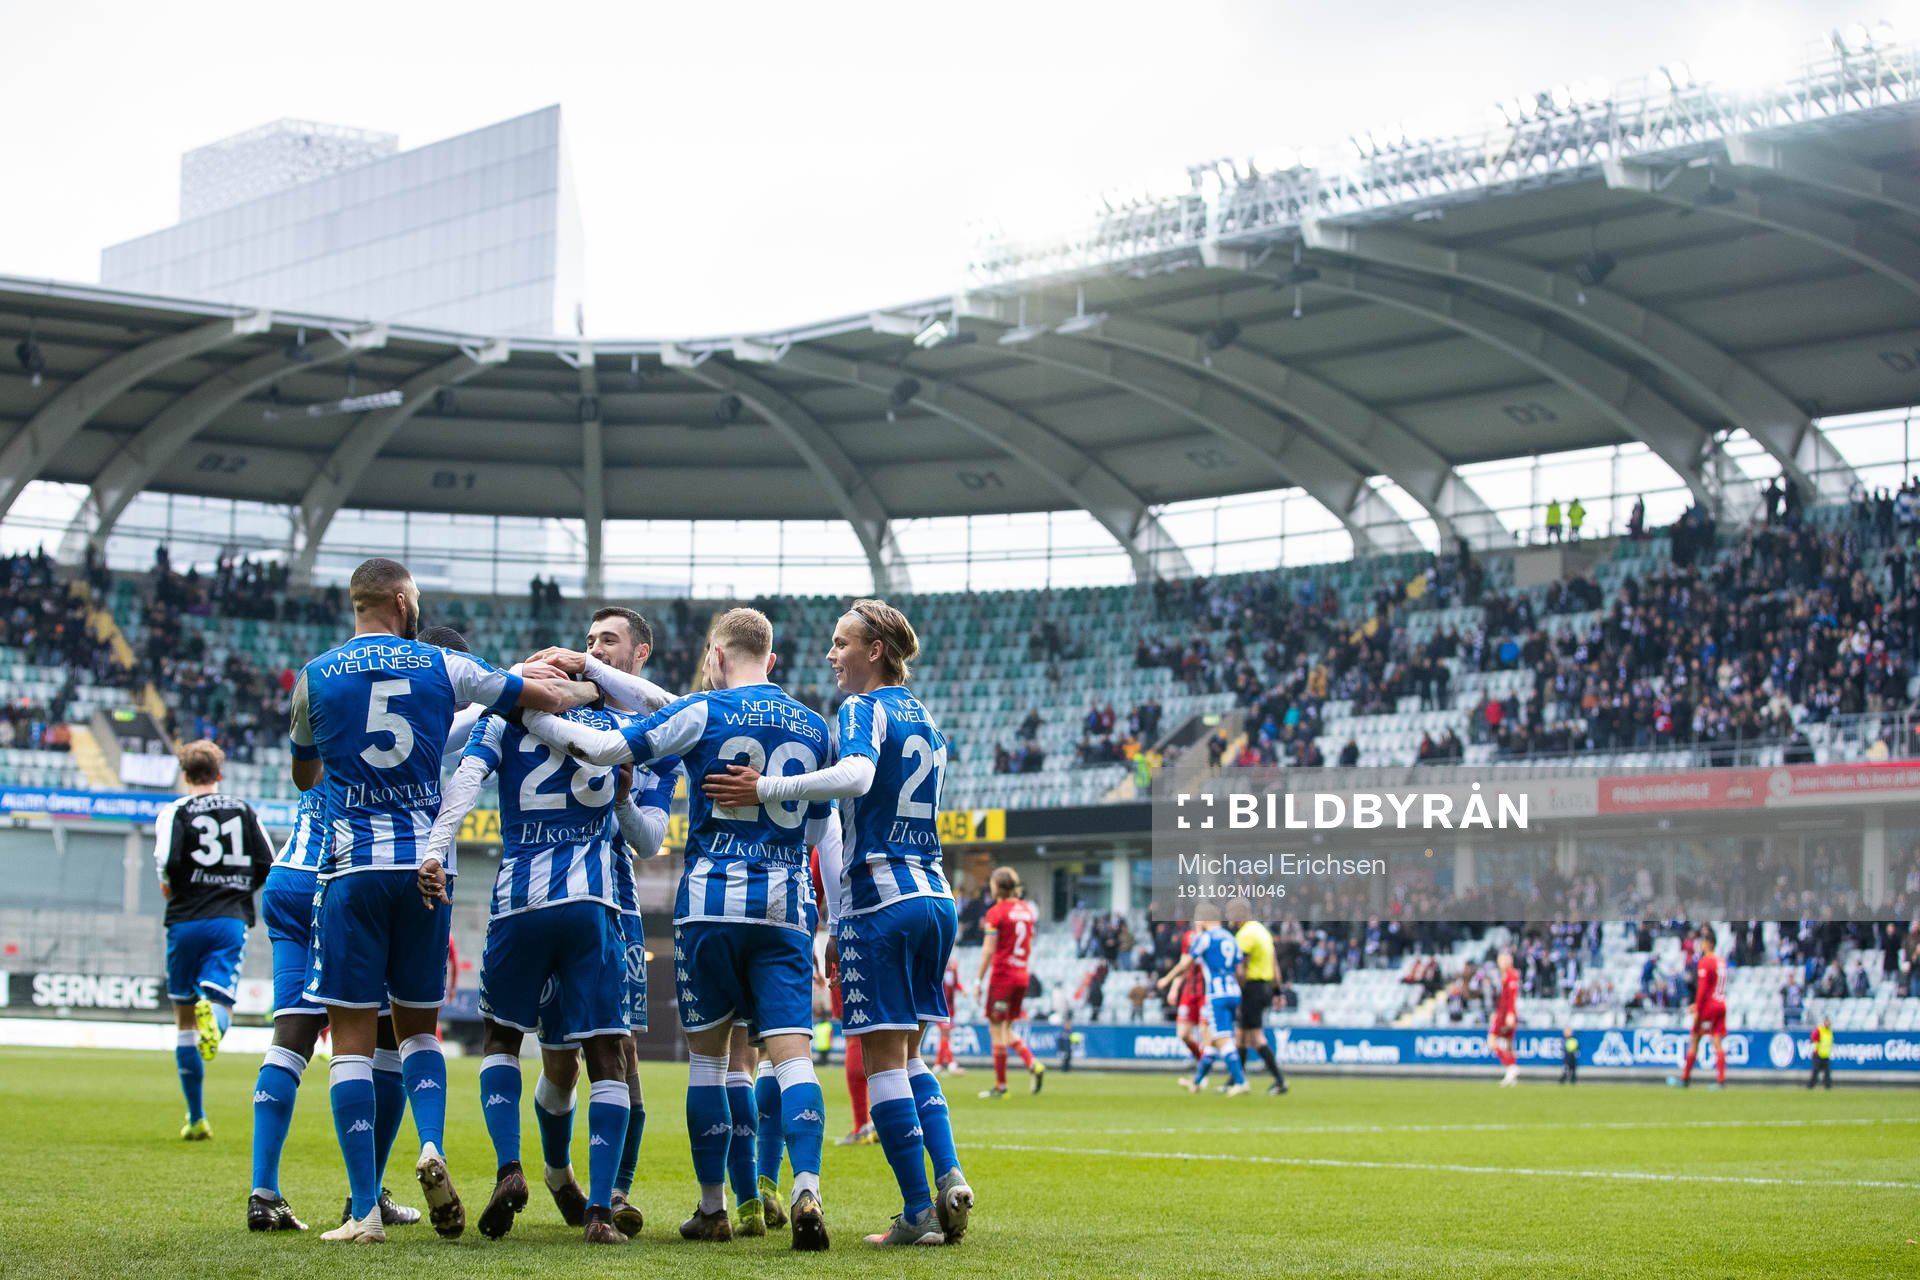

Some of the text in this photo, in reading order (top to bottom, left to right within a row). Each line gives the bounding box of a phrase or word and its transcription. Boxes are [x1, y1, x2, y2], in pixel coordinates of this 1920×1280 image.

[320, 655, 433, 678] WELLNESS
[337, 644, 412, 660] NORDIC
[360, 678, 414, 768] 5
[723, 712, 822, 743] WELLNESS
[741, 699, 808, 723] NORDIC
[711, 735, 818, 829] 20
[896, 734, 947, 821] 21
[190, 815, 252, 867] 31
[1013, 921, 1027, 957] 2
[1221, 940, 1235, 967] 9
[32, 974, 159, 1009] SERNEKE
